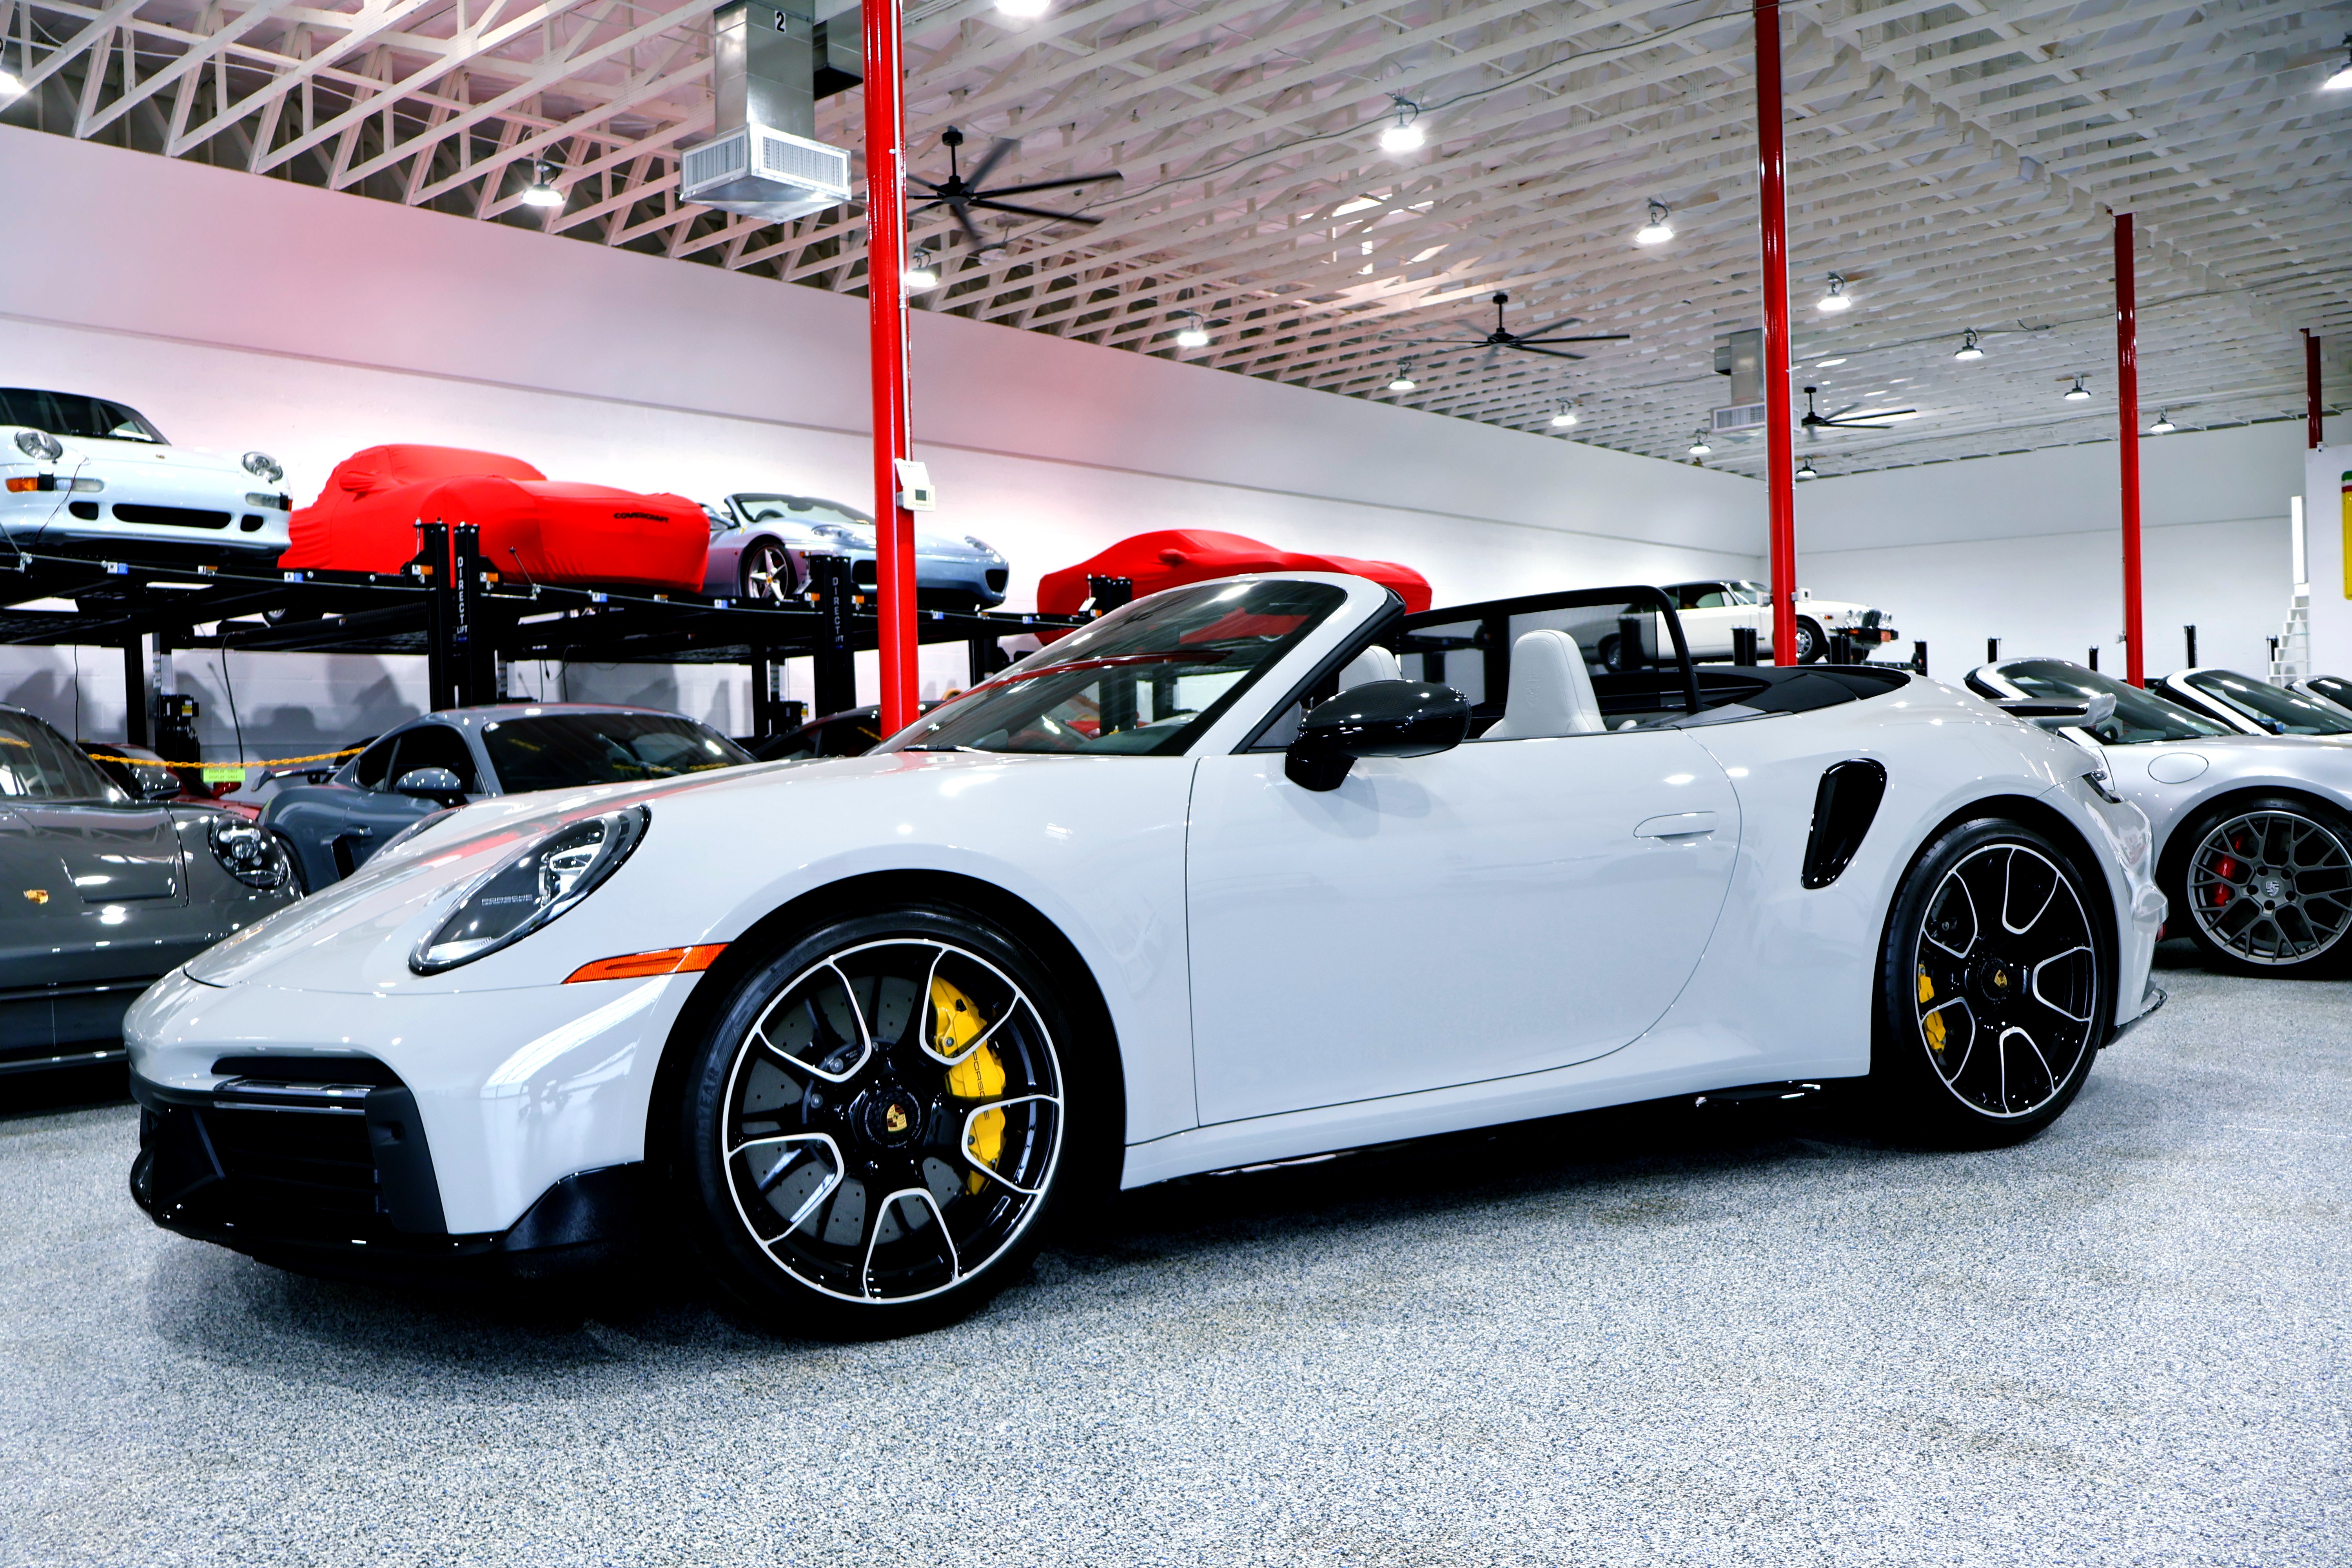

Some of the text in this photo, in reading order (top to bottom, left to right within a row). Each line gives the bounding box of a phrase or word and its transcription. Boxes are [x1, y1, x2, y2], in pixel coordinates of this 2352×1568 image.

[777, 12, 784, 32] 2
[482, 894, 533, 903] PORSCHE
[973, 1051, 989, 1120] PORSCE
